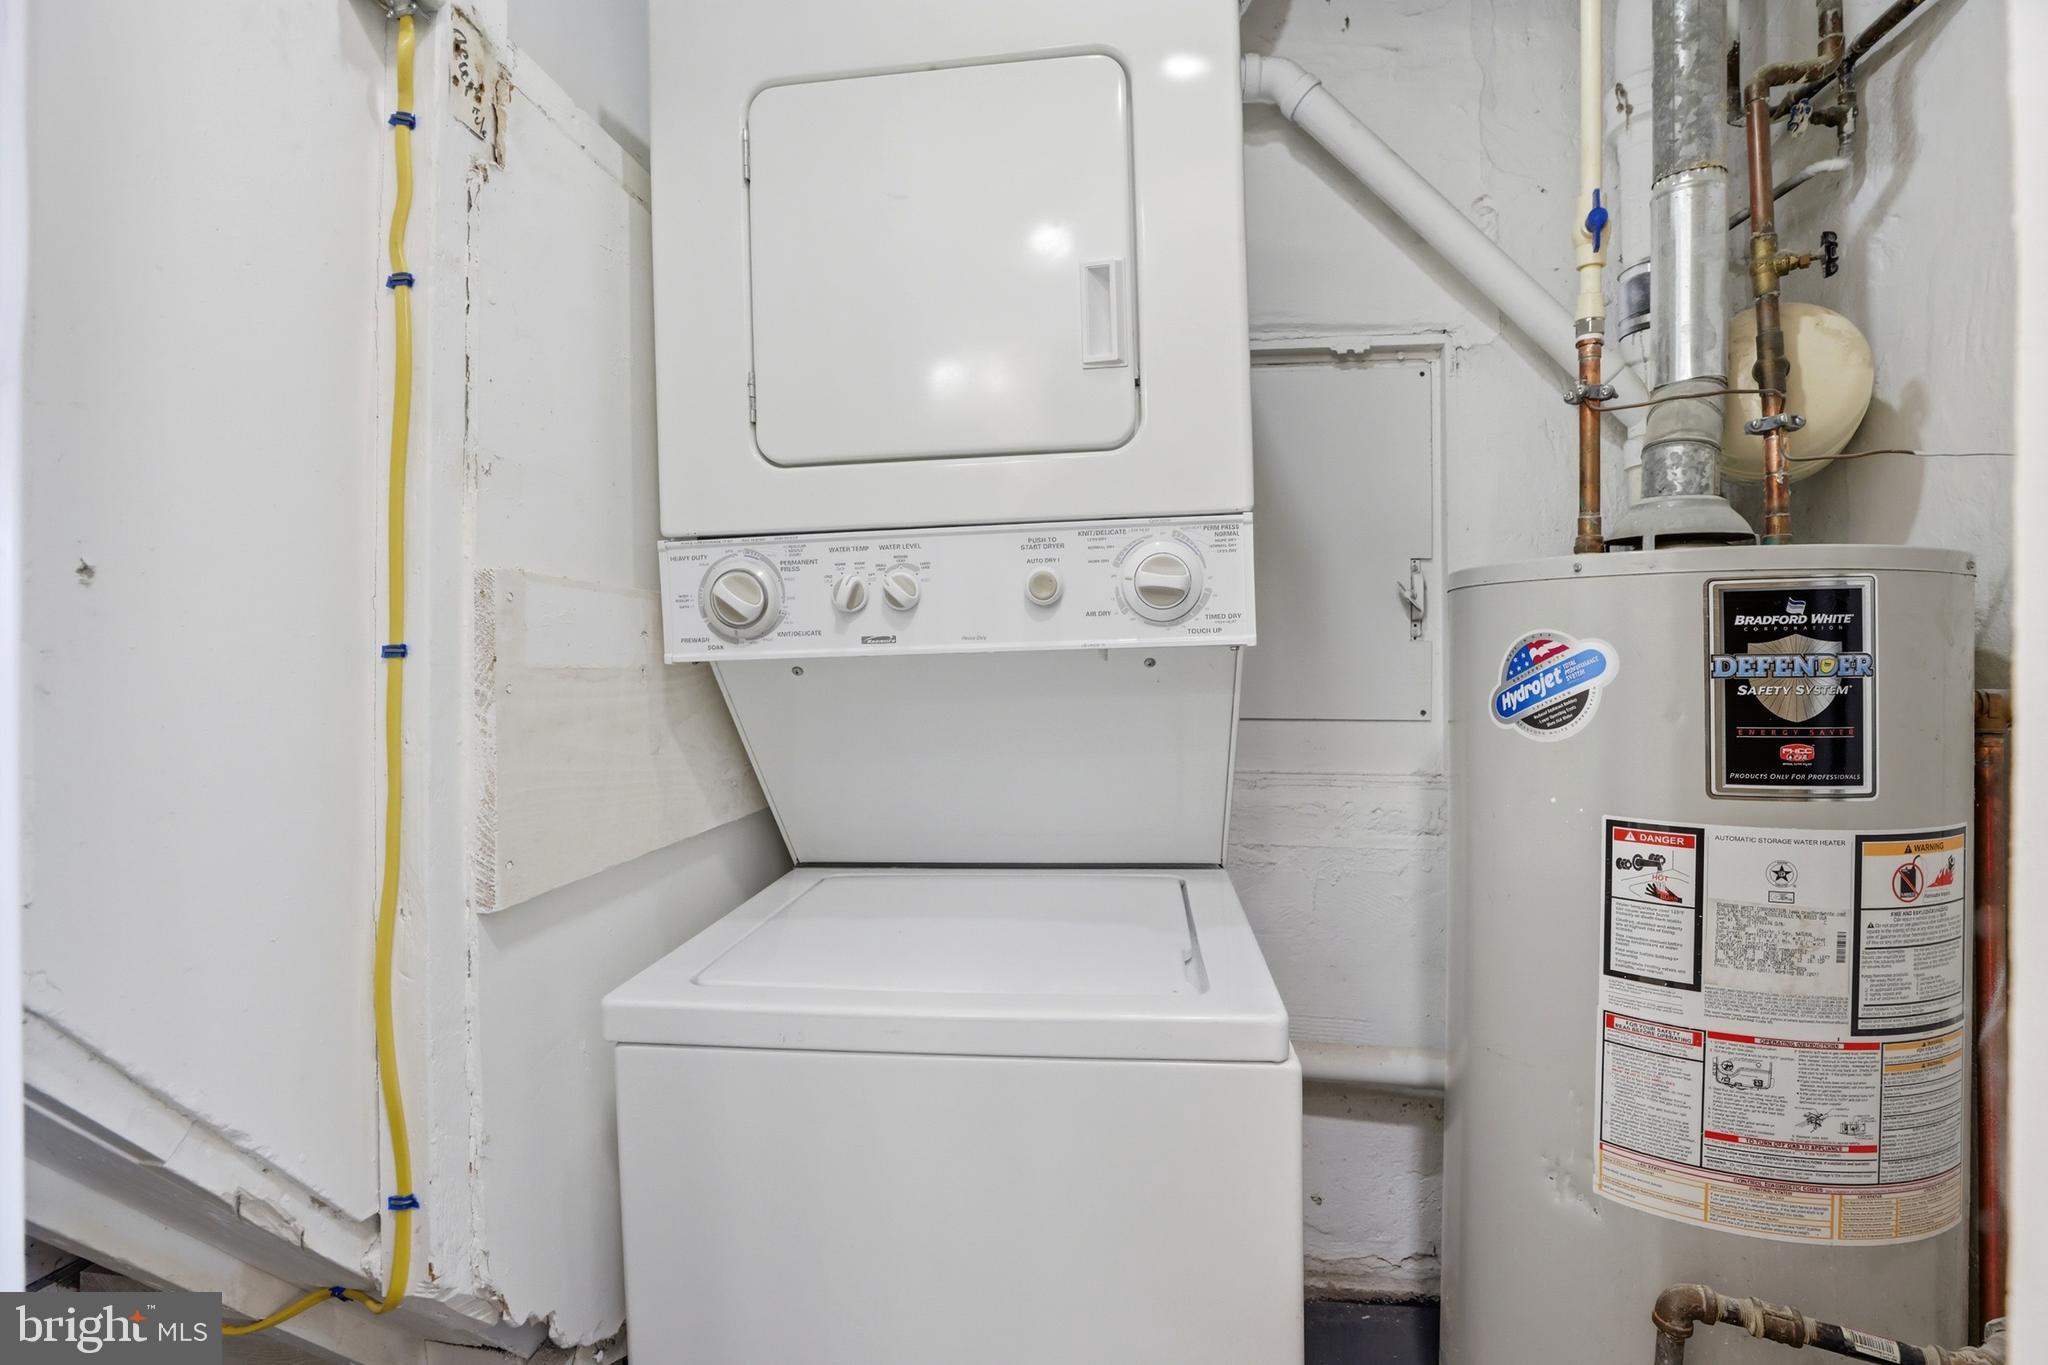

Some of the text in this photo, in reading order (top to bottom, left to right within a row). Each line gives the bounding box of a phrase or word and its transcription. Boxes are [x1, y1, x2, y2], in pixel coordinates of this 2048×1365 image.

[1078, 528, 1127, 537] KNIT/DELICATE
[1734, 614, 1852, 626] BRADFORD WHITE
[1711, 653, 1874, 678] DEFENDER
[1502, 667, 1563, 711] Hydrojet
[1737, 685, 1849, 696] SAFETY SYSTEM
[1640, 833, 1685, 846] DANGER
[1714, 835, 1757, 844] AUTOMATIC
[1913, 842, 1944, 852] WARNING
[1652, 874, 1668, 882] HOT
[1657, 1028, 1680, 1036] SAFETY
